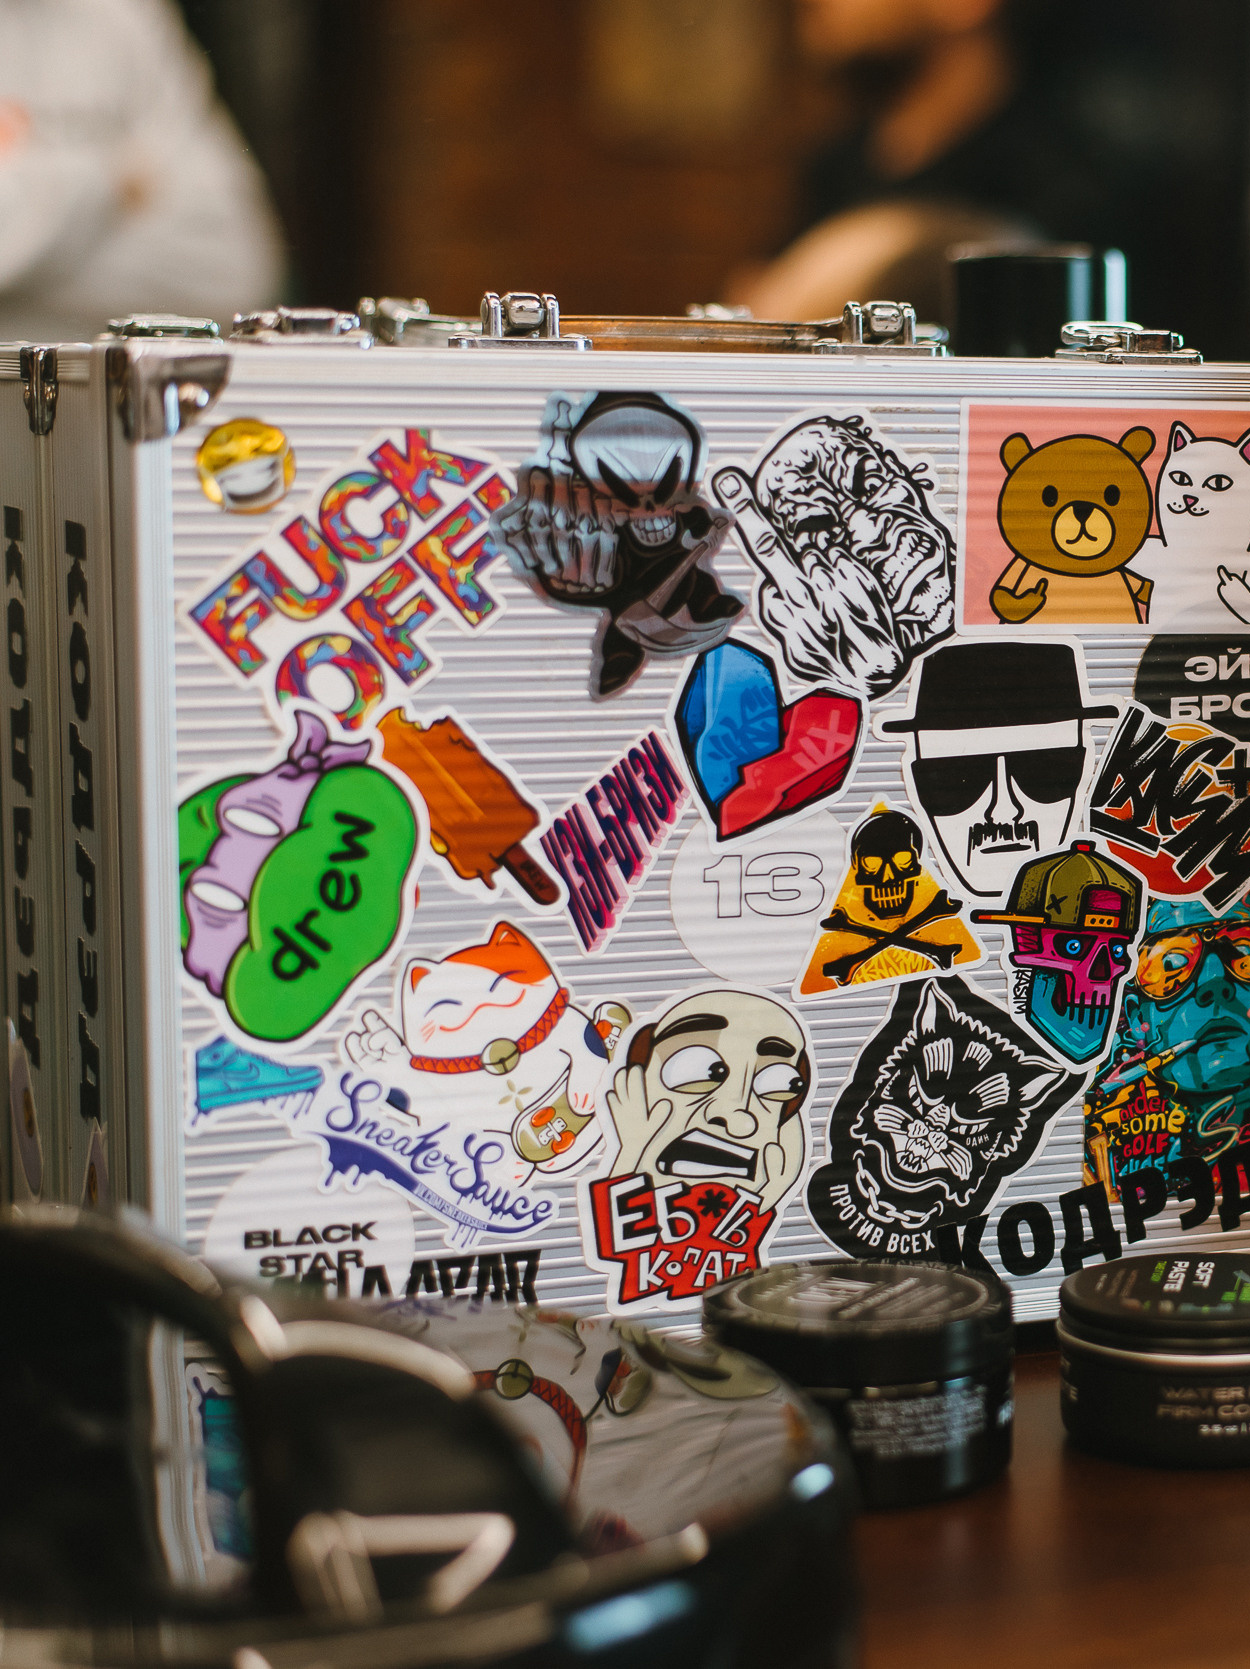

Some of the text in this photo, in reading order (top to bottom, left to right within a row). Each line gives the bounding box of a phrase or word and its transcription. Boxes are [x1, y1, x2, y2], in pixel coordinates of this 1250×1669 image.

[189, 428, 491, 678] FUCK
[1184, 647, 1250, 682] ЭЙ
[271, 811, 375, 982] drew
[703, 851, 826, 918] 13
[1120, 1081, 1168, 1121] order
[1121, 1107, 1186, 1135] some
[326, 1071, 553, 1223] Sneaker Sauce
[243, 1221, 378, 1250] BLACK
[829, 1184, 936, 1255] ПРОТИВ ВСЕХ
[259, 1249, 365, 1278] STAR
